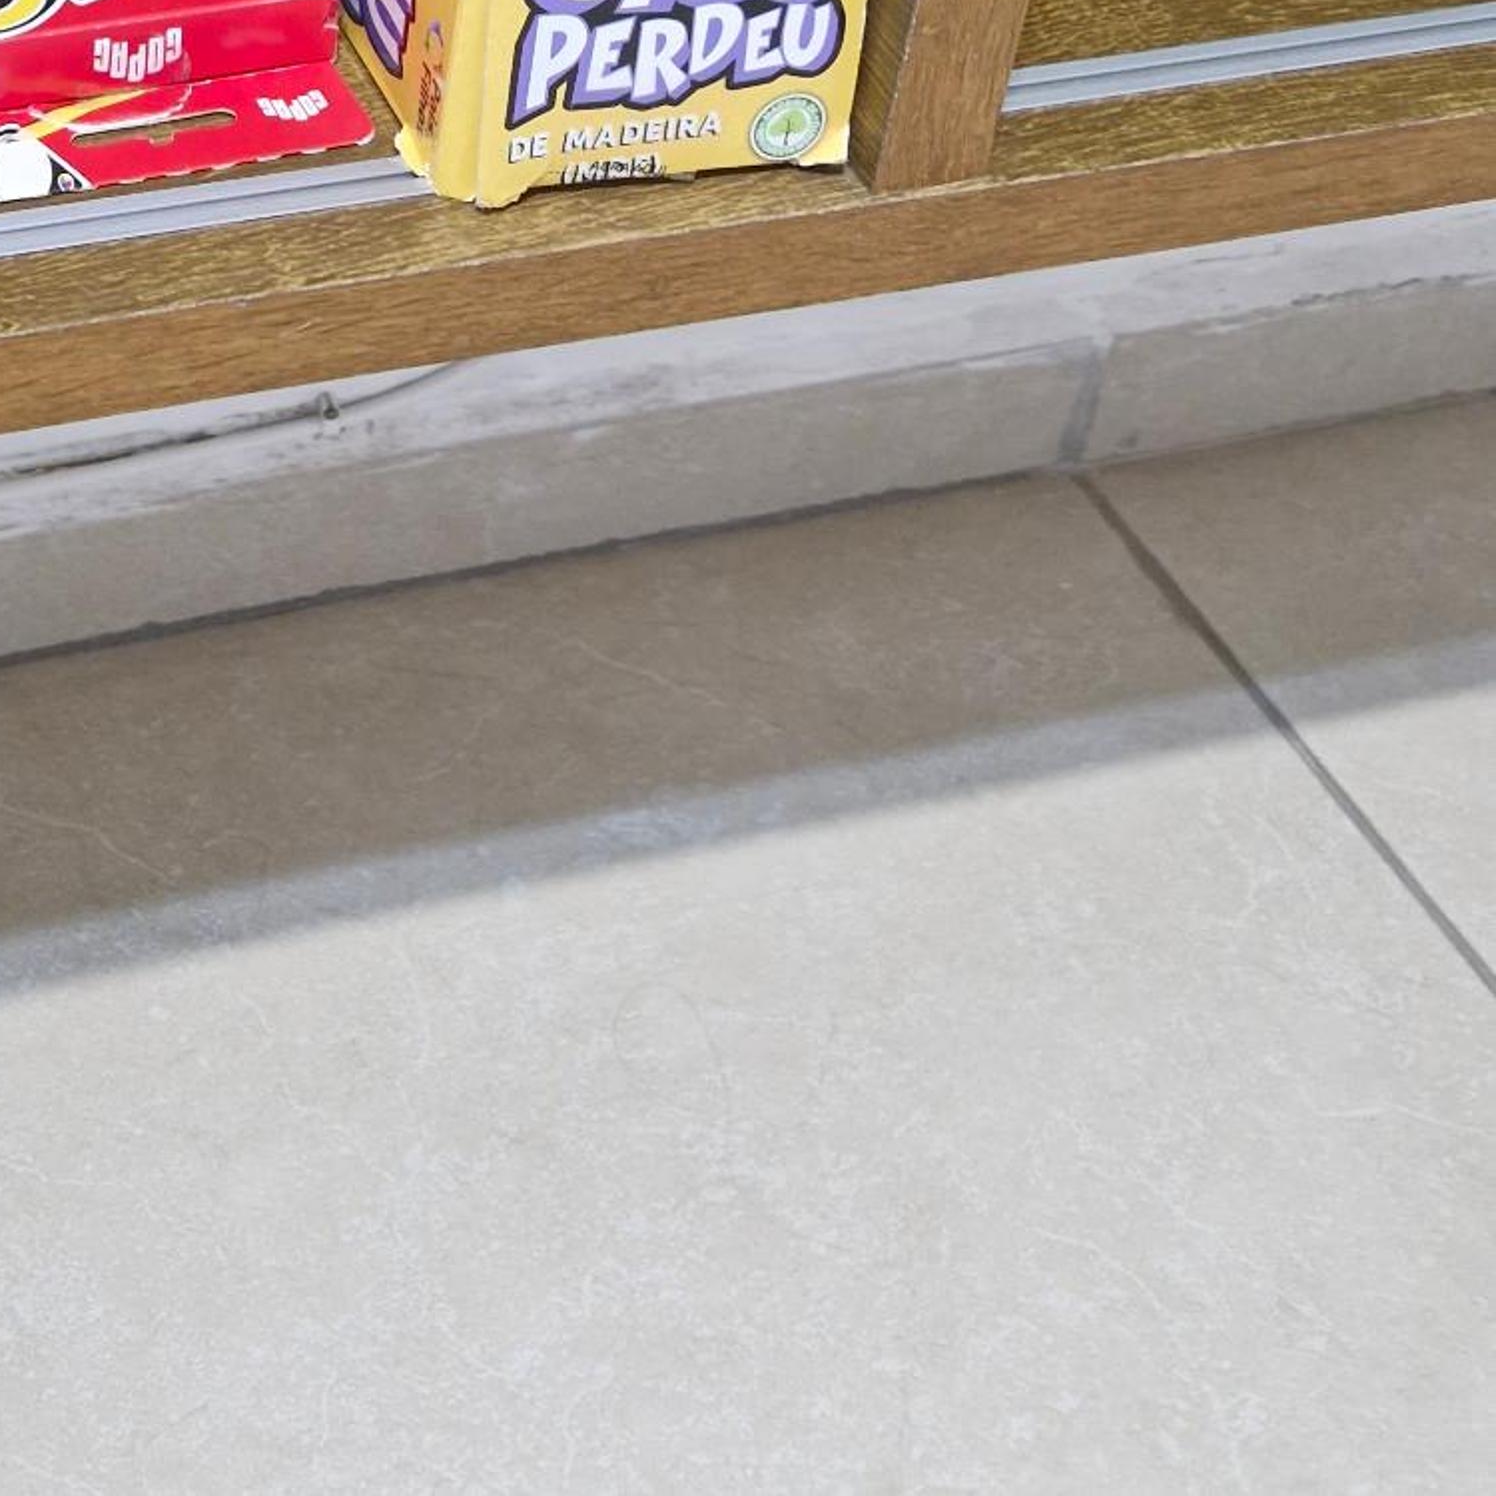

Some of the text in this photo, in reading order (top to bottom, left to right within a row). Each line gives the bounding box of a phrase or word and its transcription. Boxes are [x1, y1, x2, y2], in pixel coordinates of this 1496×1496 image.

[93, 26, 184, 84] COPAG
[505, 1, 845, 128] PERDEU
[256, 88, 330, 122] COPAG
[507, 128, 548, 164] DE
[560, 112, 724, 154] MADEIRA
